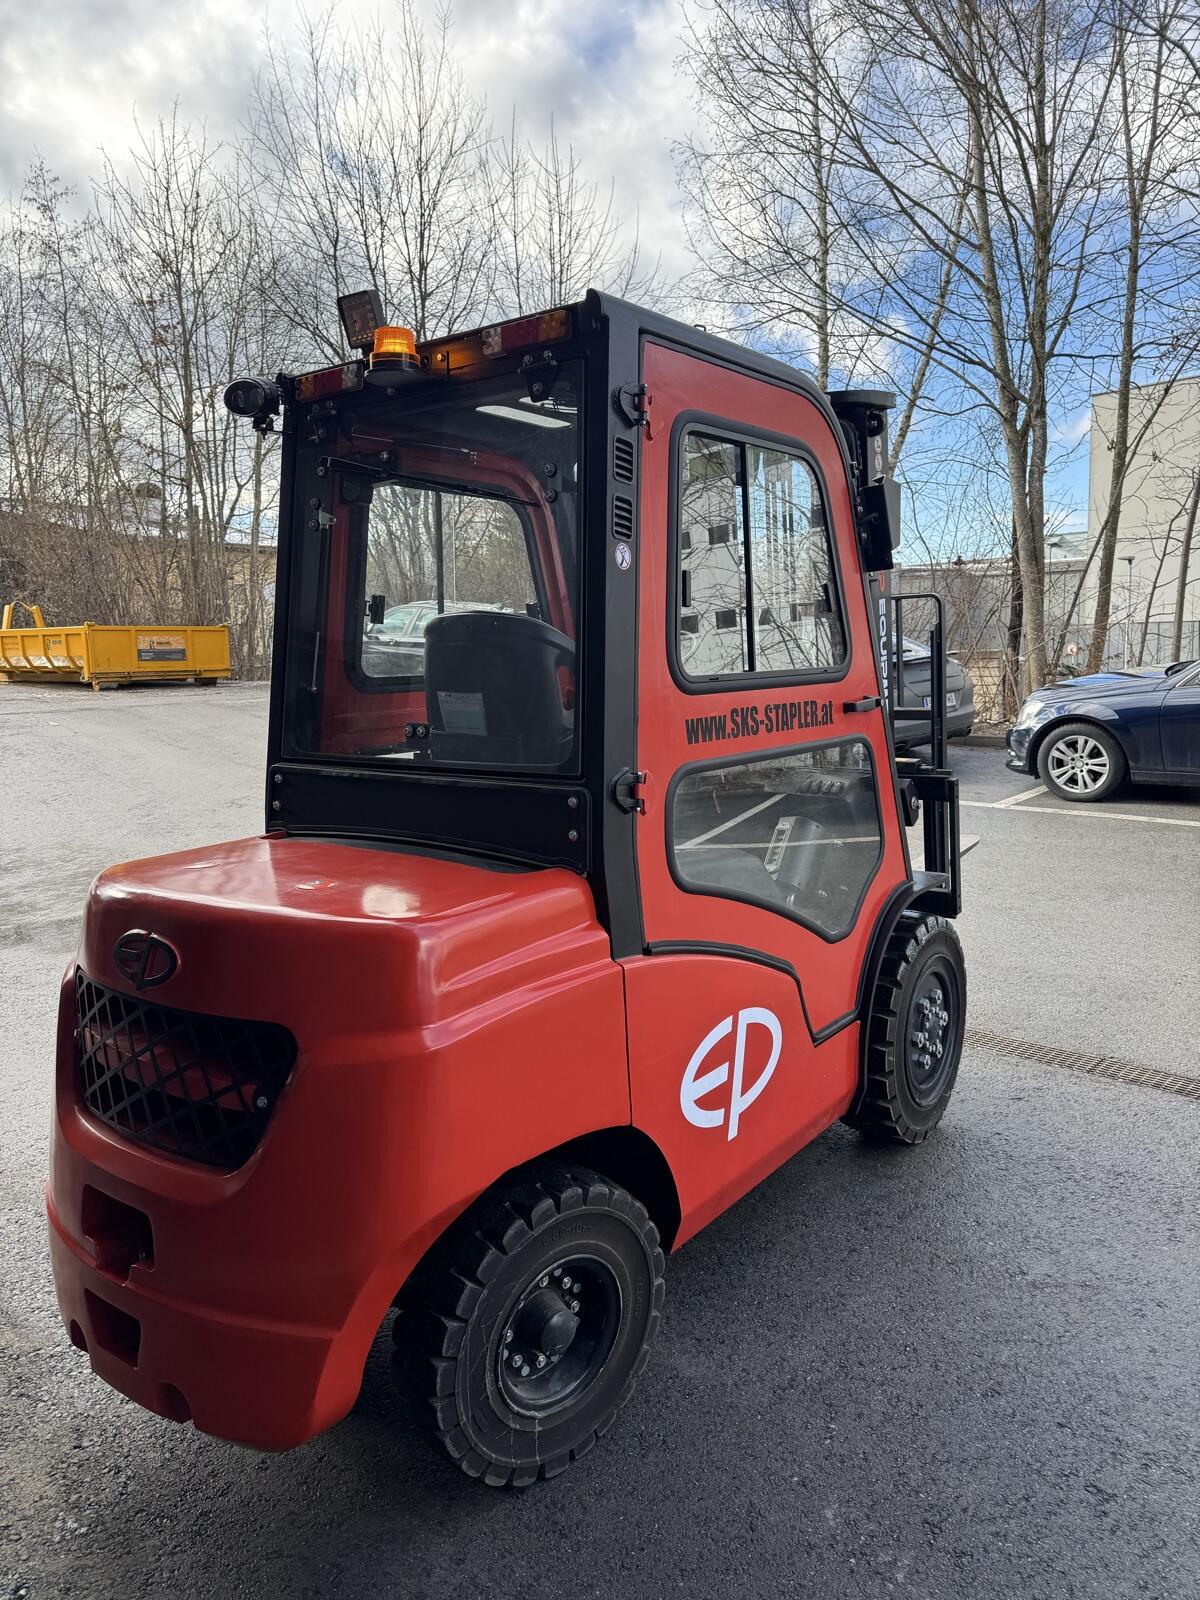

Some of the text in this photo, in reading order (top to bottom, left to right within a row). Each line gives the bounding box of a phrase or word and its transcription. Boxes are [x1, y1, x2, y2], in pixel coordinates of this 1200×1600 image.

[685, 700, 834, 745] WWW.SKS-STAPLER.at
[113, 928, 181, 991] EP
[680, 1007, 783, 1142] EP
